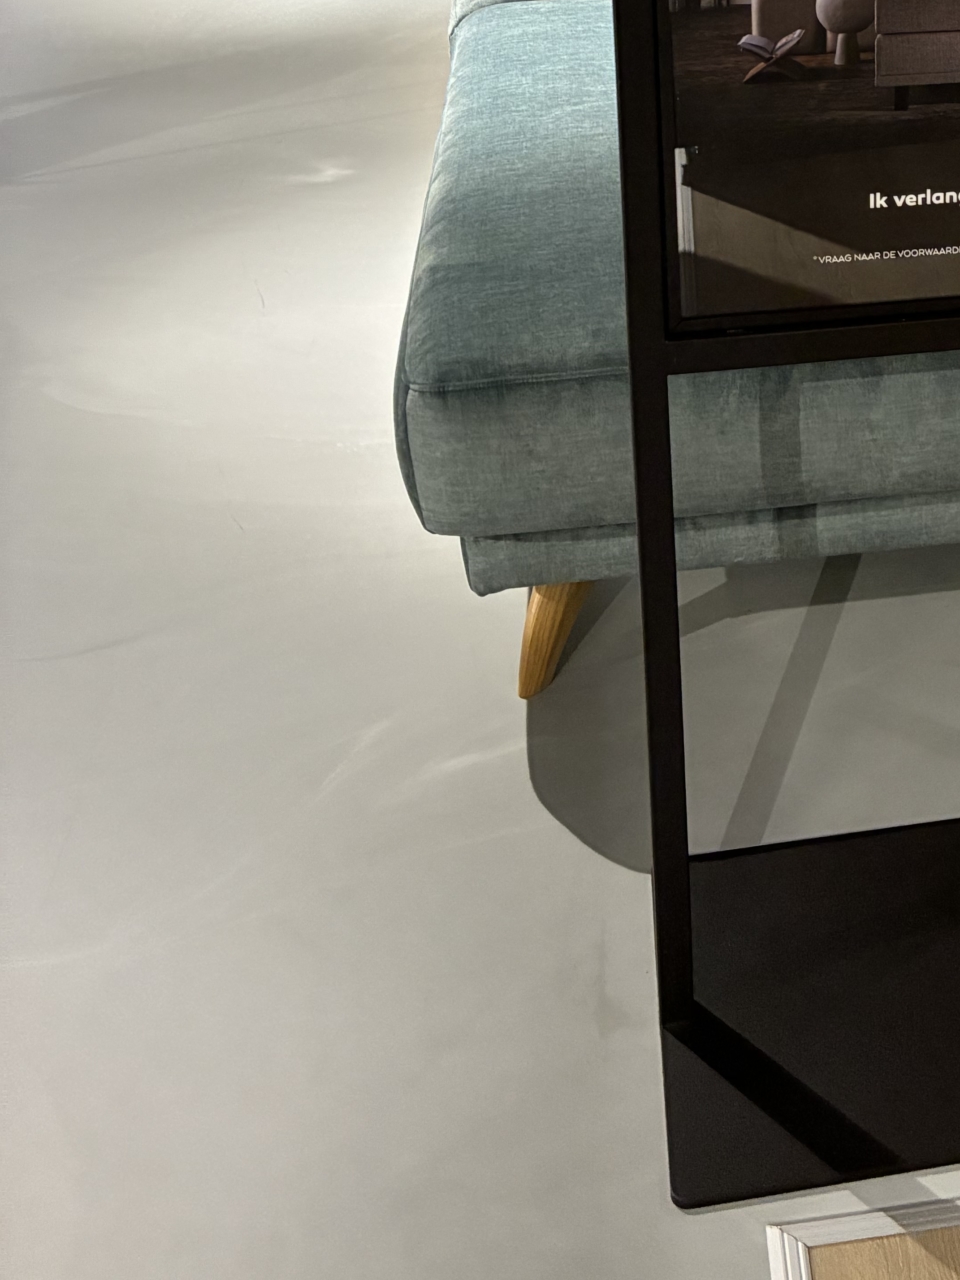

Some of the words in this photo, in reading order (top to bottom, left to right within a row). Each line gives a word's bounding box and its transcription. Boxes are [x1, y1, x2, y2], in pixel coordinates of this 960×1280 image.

[869, 192, 888, 209] Ik
[854, 252, 881, 262] NAAR
[883, 251, 896, 260] DE
